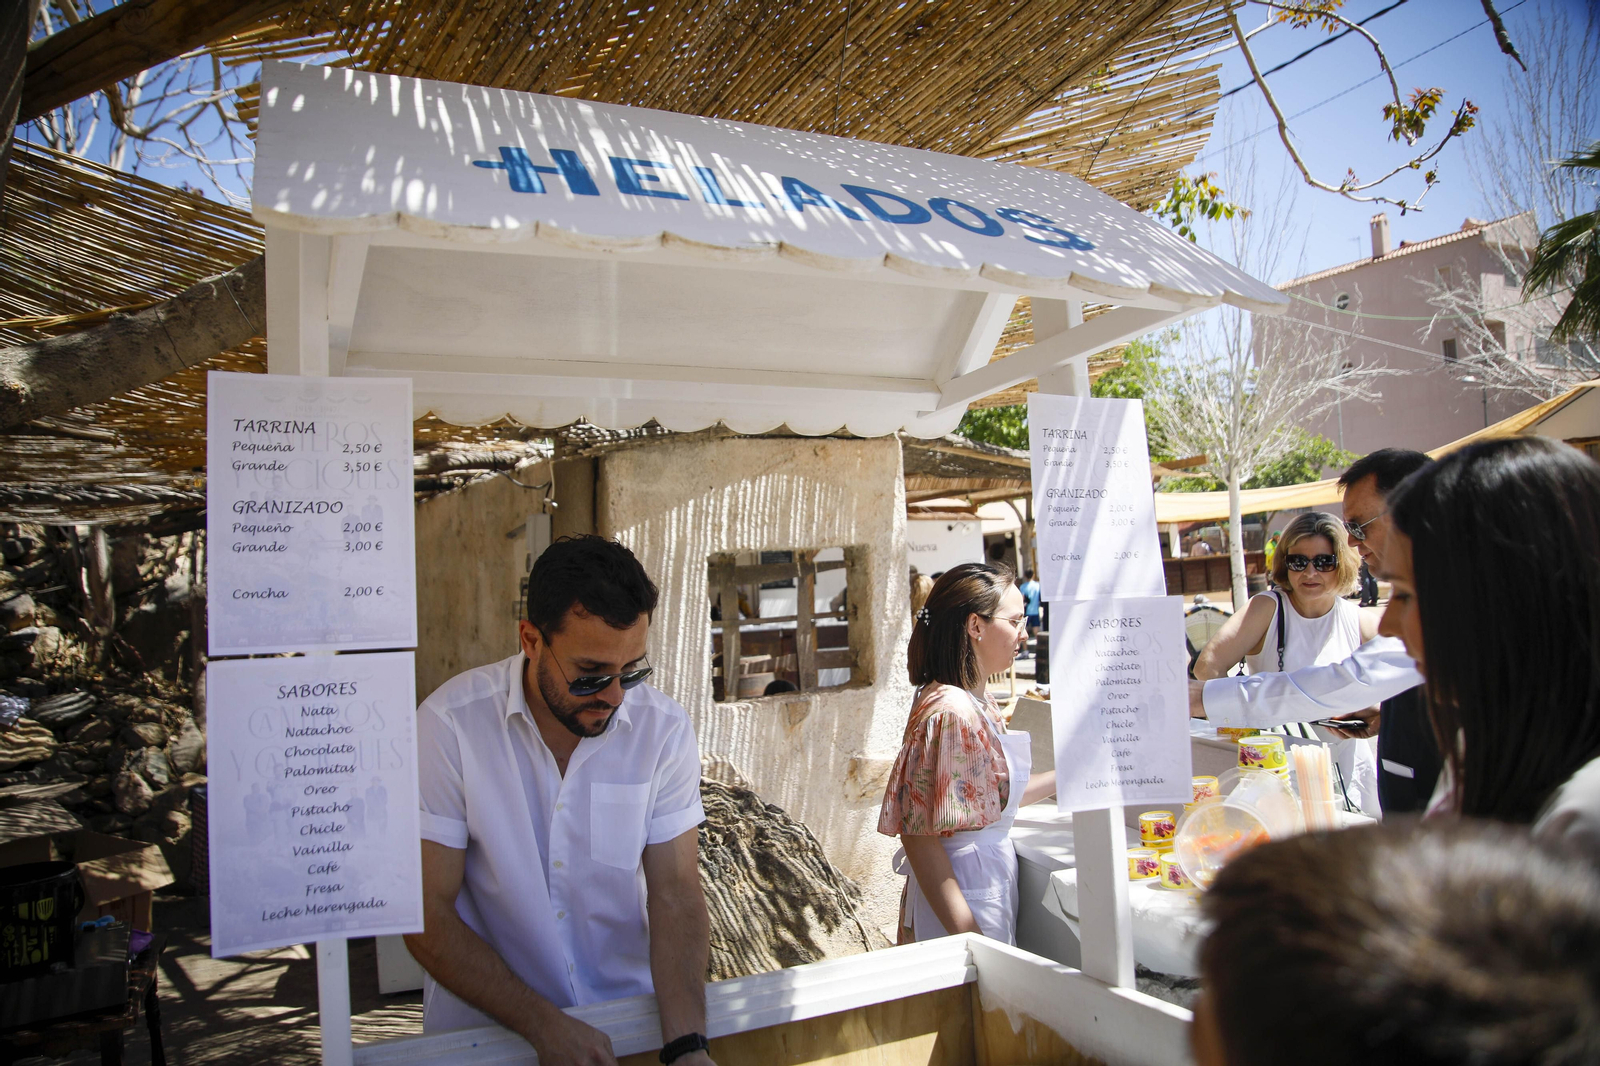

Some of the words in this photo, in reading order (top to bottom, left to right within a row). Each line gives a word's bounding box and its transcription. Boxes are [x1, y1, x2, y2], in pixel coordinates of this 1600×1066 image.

[472, 146, 1095, 251] HELADOS
[234, 418, 316, 434] TARRINA
[1042, 428, 1087, 440] TARRINA
[232, 440, 295, 456] Pequeña
[342, 443, 370, 455] 2,50
[374, 443, 382, 453] €
[1043, 445, 1077, 455] Pequeña
[232, 460, 288, 472] Grande
[343, 462, 370, 473] 3,50
[374, 462, 382, 472] €
[1044, 459, 1074, 467] Grande
[1105, 460, 1122, 468] 3,50
[1124, 460, 1129, 468] €
[1046, 488, 1108, 498] GRANIZADO
[232, 500, 343, 514] GRANIZADO
[1047, 505, 1081, 514] Pequeño
[1109, 505, 1127, 513] 2,00
[1129, 504, 1134, 512] €
[1049, 518, 1078, 527] Grande
[1111, 519, 1128, 527] 3,00
[1130, 518, 1136, 526] €
[232, 522, 294, 536] Pequeño
[343, 522, 371, 534] 2,00
[375, 522, 383, 532] €
[232, 542, 288, 553] Grande
[343, 542, 372, 553] 3,00
[375, 540, 383, 551] €
[907, 542, 937, 552] Nueva
[1051, 552, 1082, 561] Concha
[1114, 551, 1132, 560] 2,00
[232, 587, 289, 599] Concha
[344, 587, 372, 598] 2,00
[376, 586, 384, 596] €
[1089, 617, 1142, 629] SABORES
[1104, 634, 1128, 643] Nata
[1095, 648, 1139, 657] Natachoc
[1095, 662, 1141, 672] Chocolate
[1095, 676, 1141, 687] Palomitas
[277, 681, 358, 699] SABORES
[1107, 692, 1130, 700] Oreo
[300, 706, 339, 717] Nata
[1100, 705, 1140, 715] Pistacho
[1106, 720, 1135, 729] Chicle
[285, 725, 354, 738] Natachoc
[1102, 734, 1141, 744] Vainilla
[284, 743, 356, 758] Chocolate
[284, 763, 357, 779] Palomitas
[1110, 763, 1134, 772] Fresa
[1085, 780, 1110, 790] Leche
[1111, 776, 1165, 787] Merengada
[303, 785, 339, 796] Oreo
[291, 803, 353, 818] Pistacho
[300, 822, 346, 836] Chicle
[293, 842, 354, 857] Vainilla
[307, 862, 341, 875] Café
[305, 883, 345, 896] Fresa
[262, 907, 304, 922] Leche
[305, 897, 388, 916] Merengada
